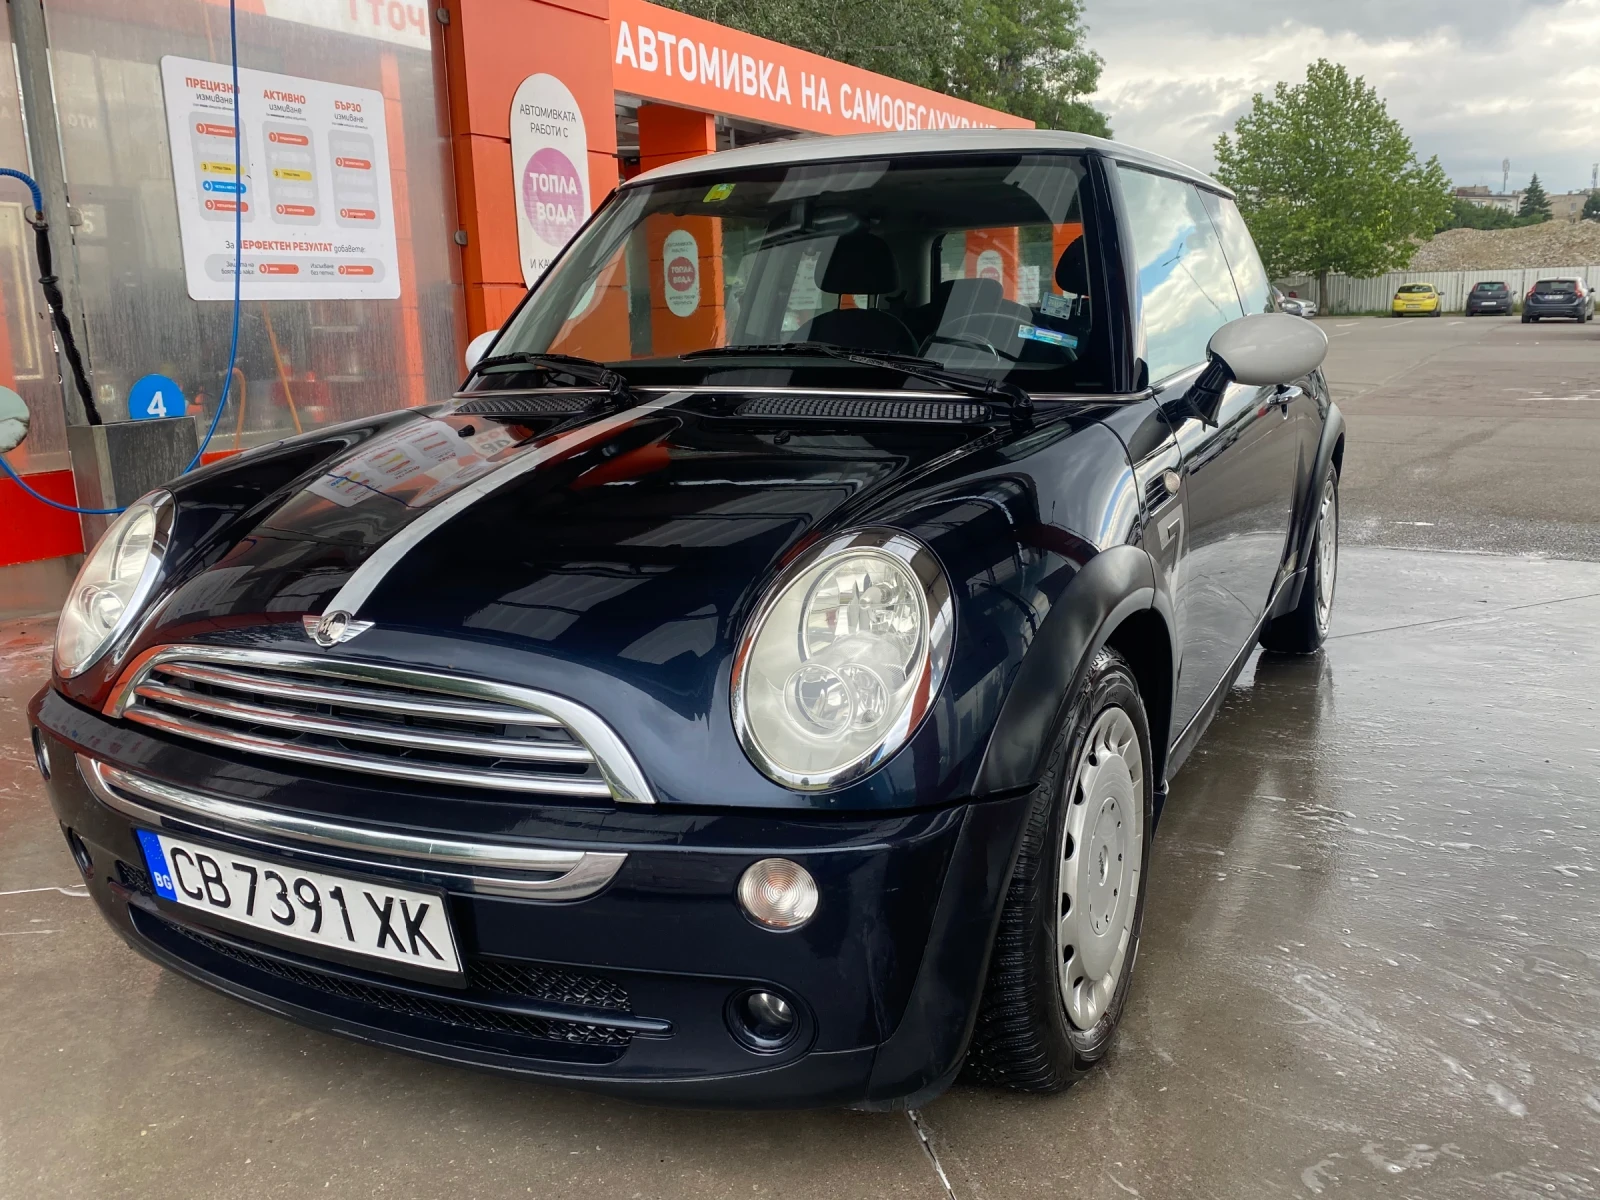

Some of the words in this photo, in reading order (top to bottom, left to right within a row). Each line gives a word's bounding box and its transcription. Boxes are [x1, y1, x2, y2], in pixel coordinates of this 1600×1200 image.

[615, 20, 792, 105] АВТОМИВКА
[800, 71, 832, 115] НА
[195, 93, 233, 105] измиване
[263, 89, 307, 105] АКТИВНО
[268, 103, 302, 115] измиване
[334, 100, 362, 113] БЪРЗО
[519, 103, 577, 123] АВТОМИВКАТА
[334, 113, 365, 124] измиване
[530, 122, 562, 137] РАБОТИ
[562, 127, 569, 138] С
[529, 172, 578, 195] ТОПЛА
[535, 201, 576, 225] ВОДА
[225, 240, 235, 249] За
[294, 241, 333, 252] РЕЗУЛТАТ
[530, 258, 536, 269] И
[146, 390, 167, 418] 4
[153, 870, 173, 890] BG
